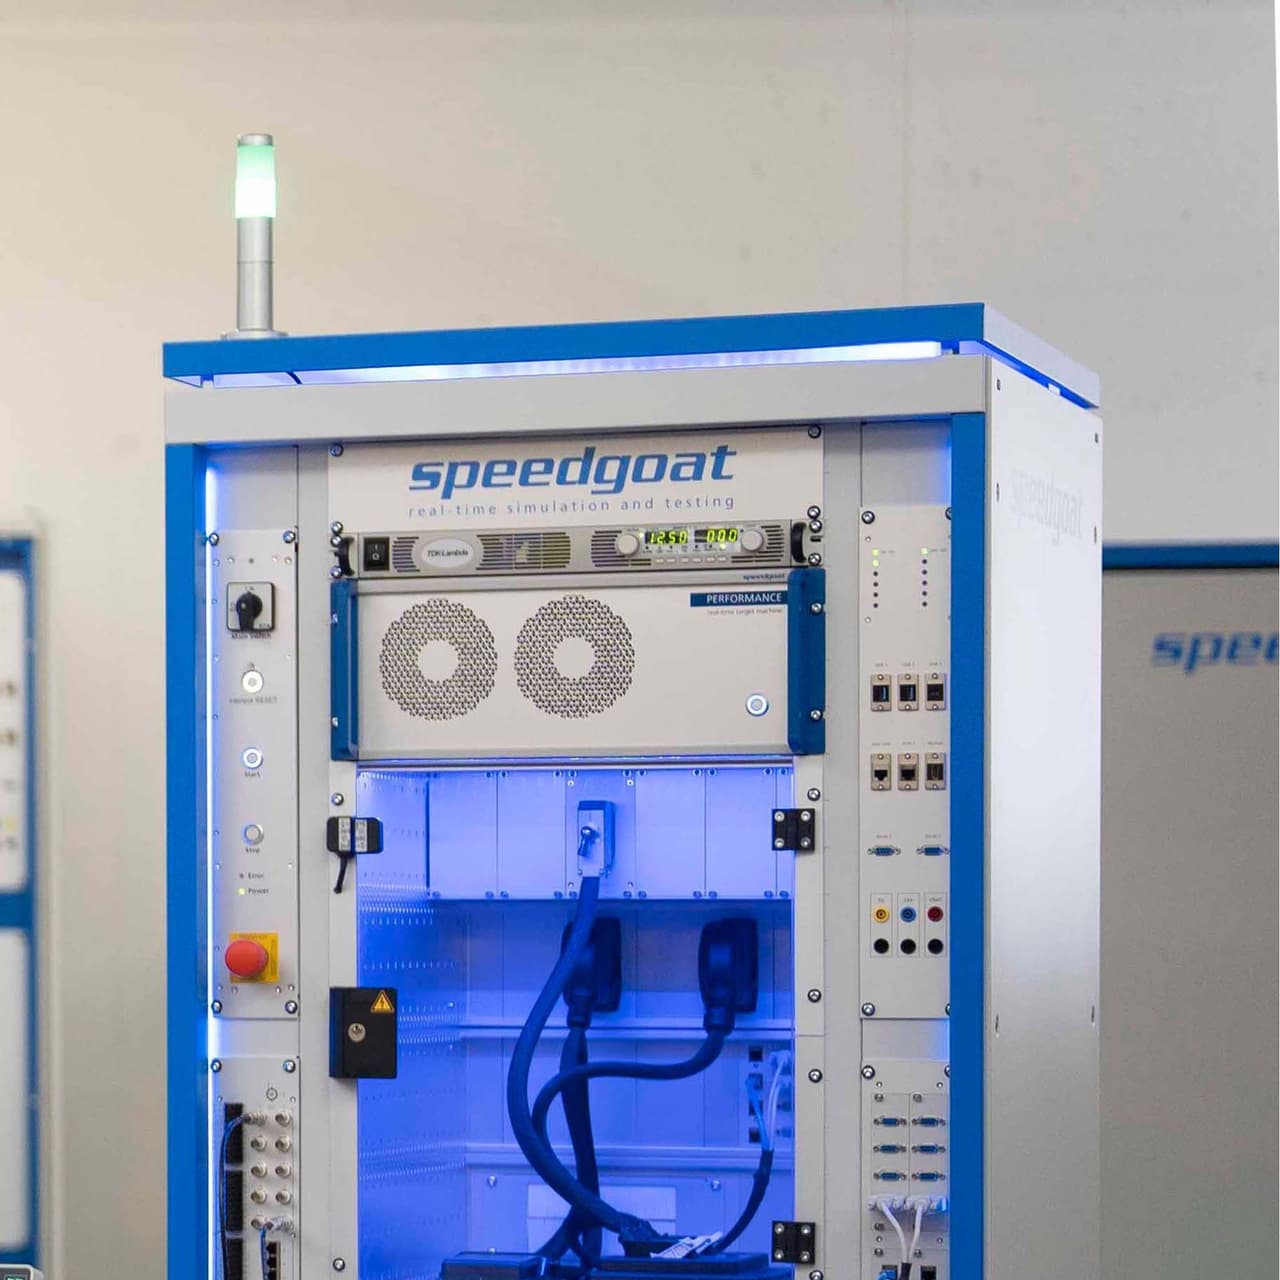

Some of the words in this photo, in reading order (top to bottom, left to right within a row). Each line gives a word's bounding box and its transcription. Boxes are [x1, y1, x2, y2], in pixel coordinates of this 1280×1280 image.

[409, 445, 737, 500] speedgoat
[409, 504, 497, 519] real-time
[507, 499, 609, 515] simulation
[621, 497, 653, 511] and
[666, 495, 735, 513] testing
[706, 592, 782, 605] PERFORMANCE
